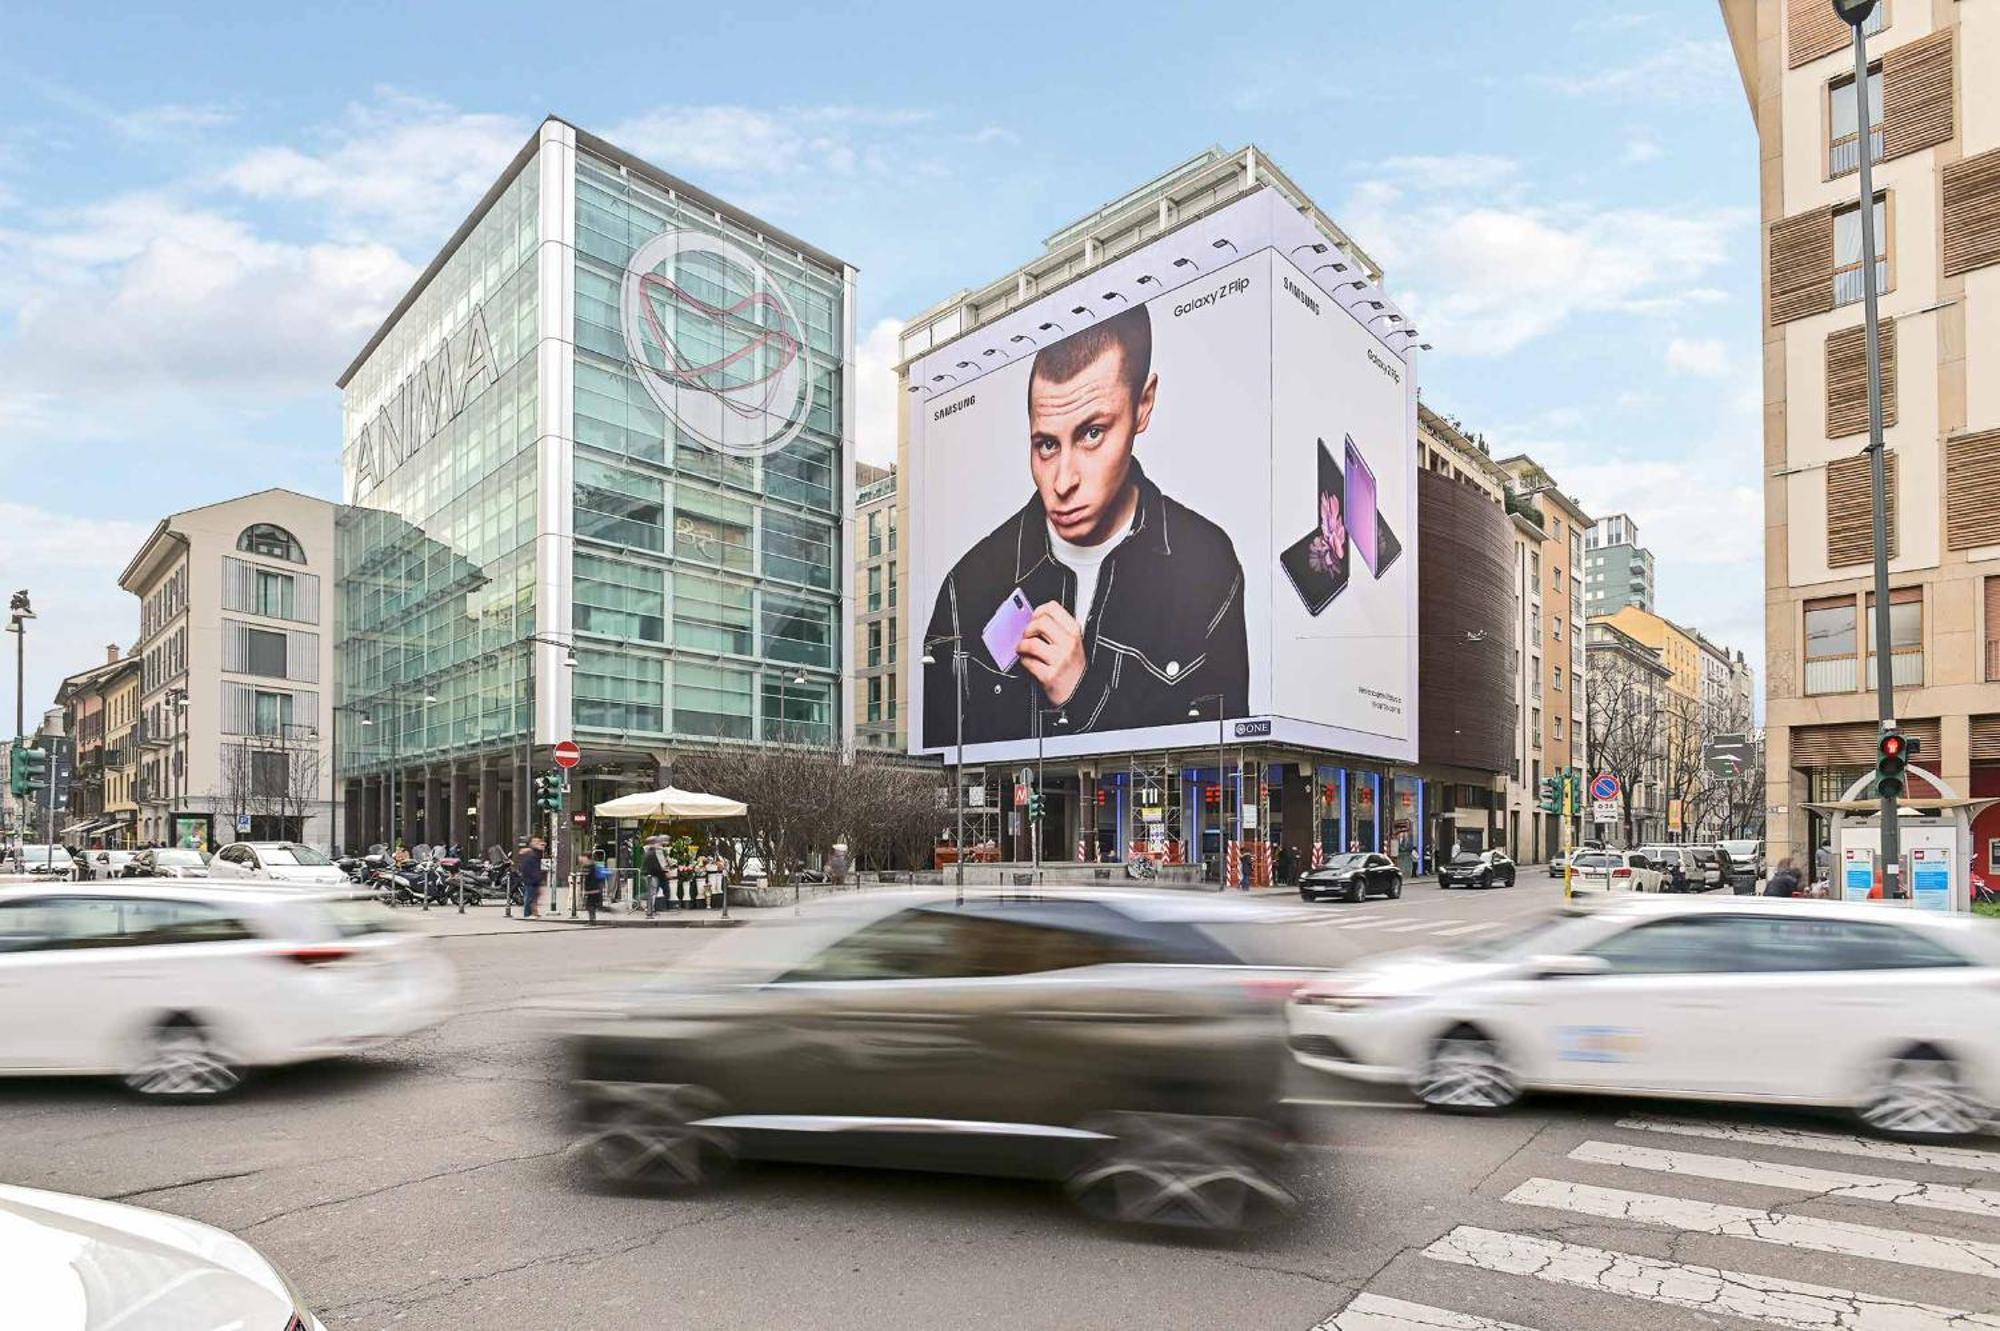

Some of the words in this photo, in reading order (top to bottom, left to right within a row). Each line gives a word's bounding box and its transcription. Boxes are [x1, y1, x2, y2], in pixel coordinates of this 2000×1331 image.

[1173, 290, 1218, 317] Galaxy
[1219, 284, 1228, 299] Z
[1228, 277, 1250, 294] Flip
[1283, 276, 1320, 316] SAMSUNG
[352, 302, 500, 509] ANIMA
[933, 394, 976, 421] SAMSUNG
[1246, 722, 1269, 733] ONE
